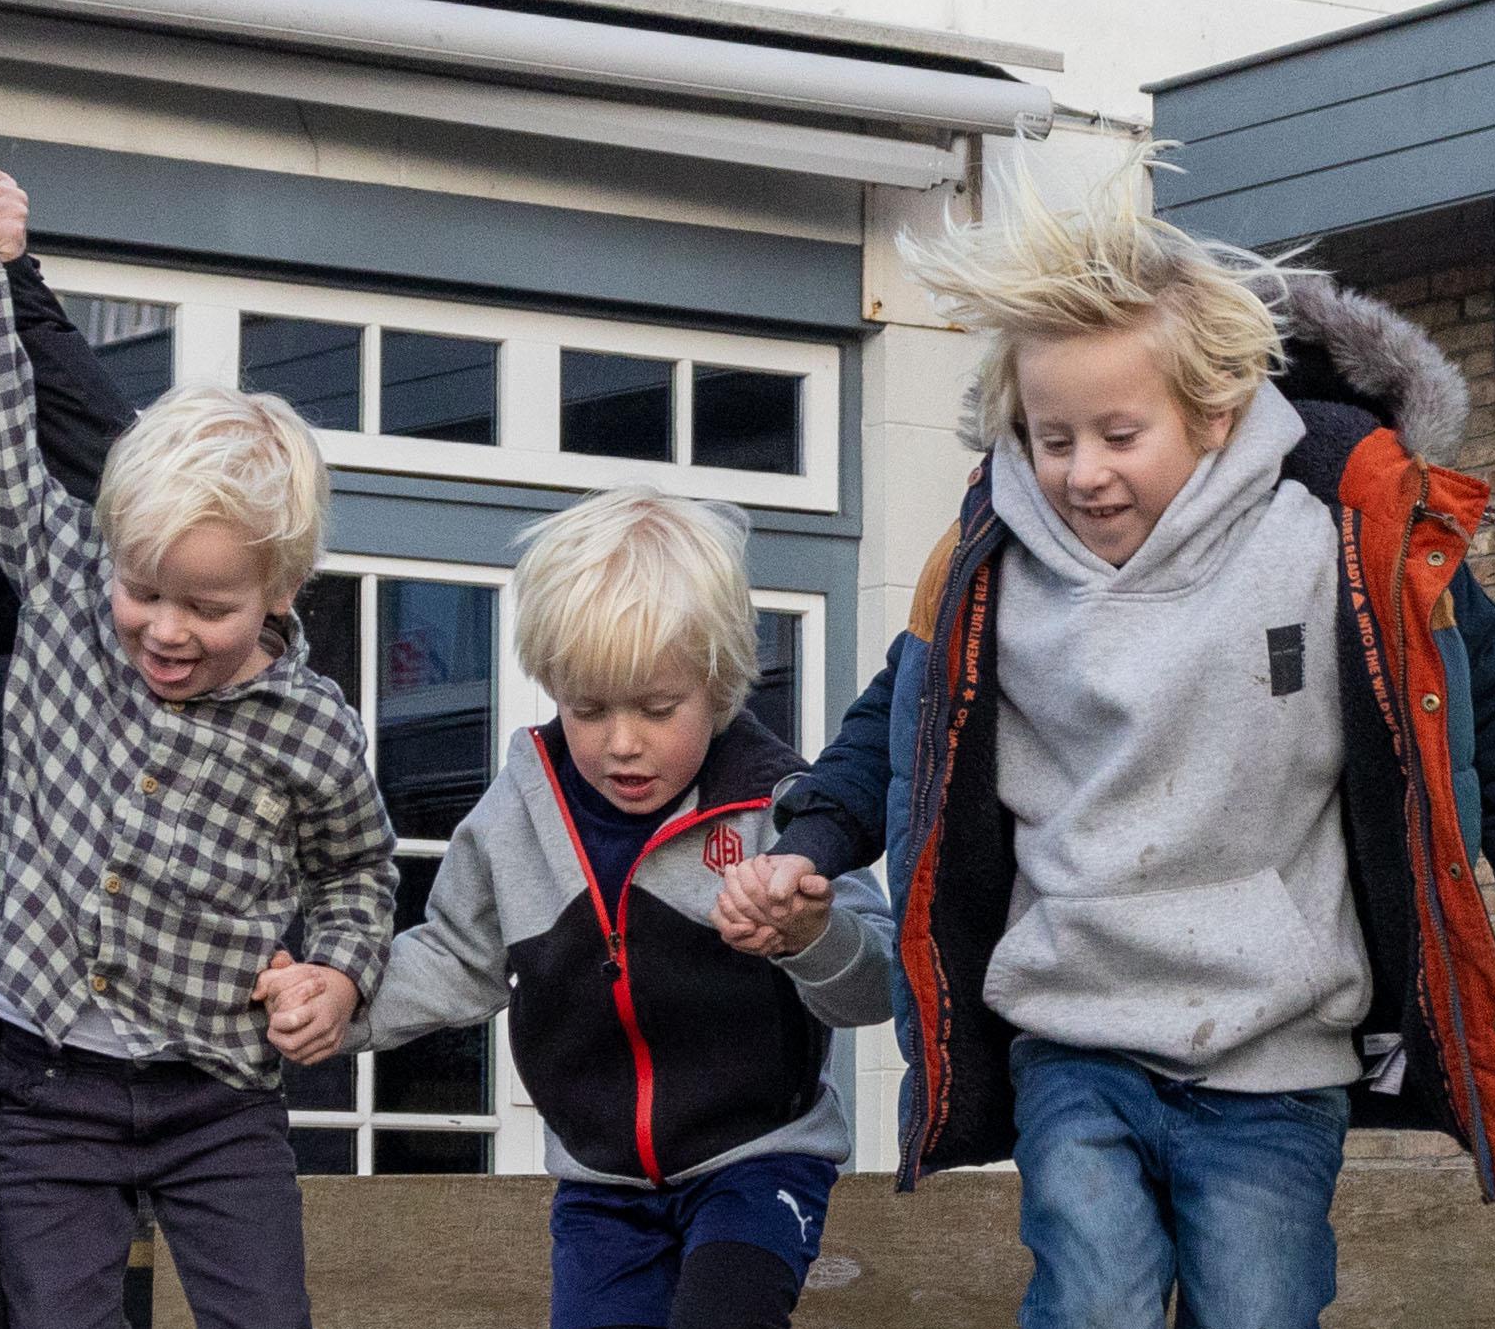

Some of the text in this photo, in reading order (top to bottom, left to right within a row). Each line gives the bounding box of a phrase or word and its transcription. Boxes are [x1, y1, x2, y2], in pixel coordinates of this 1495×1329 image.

[974, 562, 990, 602] READ
[1345, 545, 1363, 589] READY
[965, 603, 986, 685] ADVENTURE
[1357, 612, 1375, 648] INTO
[1364, 647, 1382, 675] THE
